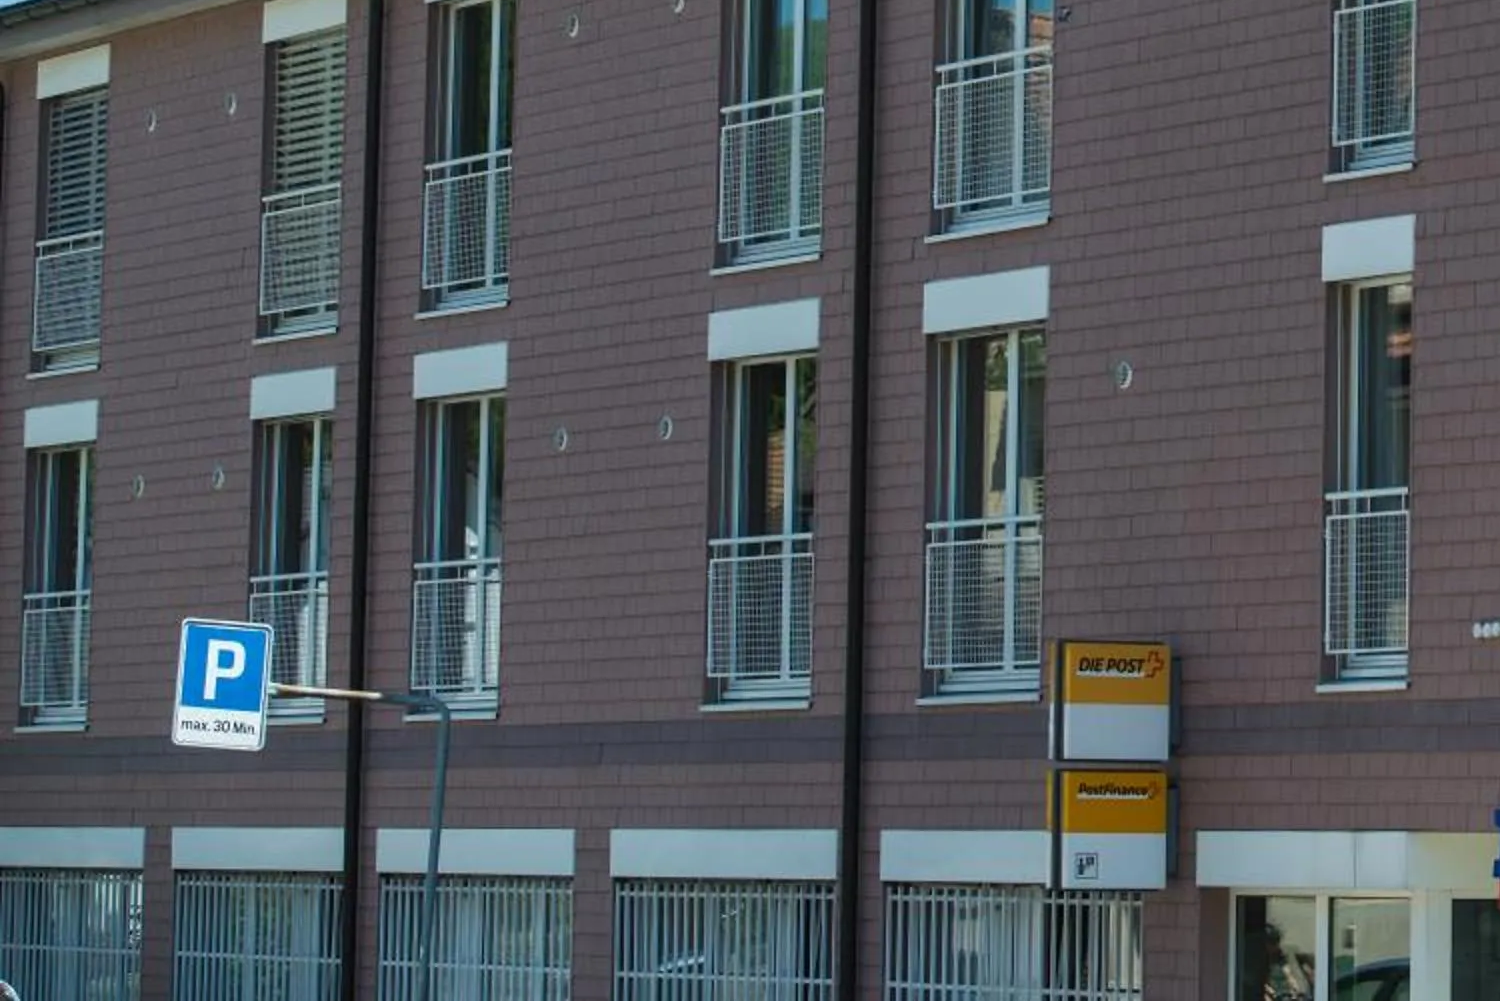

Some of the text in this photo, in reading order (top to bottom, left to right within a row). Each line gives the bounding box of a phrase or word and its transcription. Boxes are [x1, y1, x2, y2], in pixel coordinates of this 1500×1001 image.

[204, 639, 246, 700] P
[1078, 657, 1145, 674] DIE POST
[213, 720, 231, 734] 30
[1078, 782, 1148, 797] PostFinance
